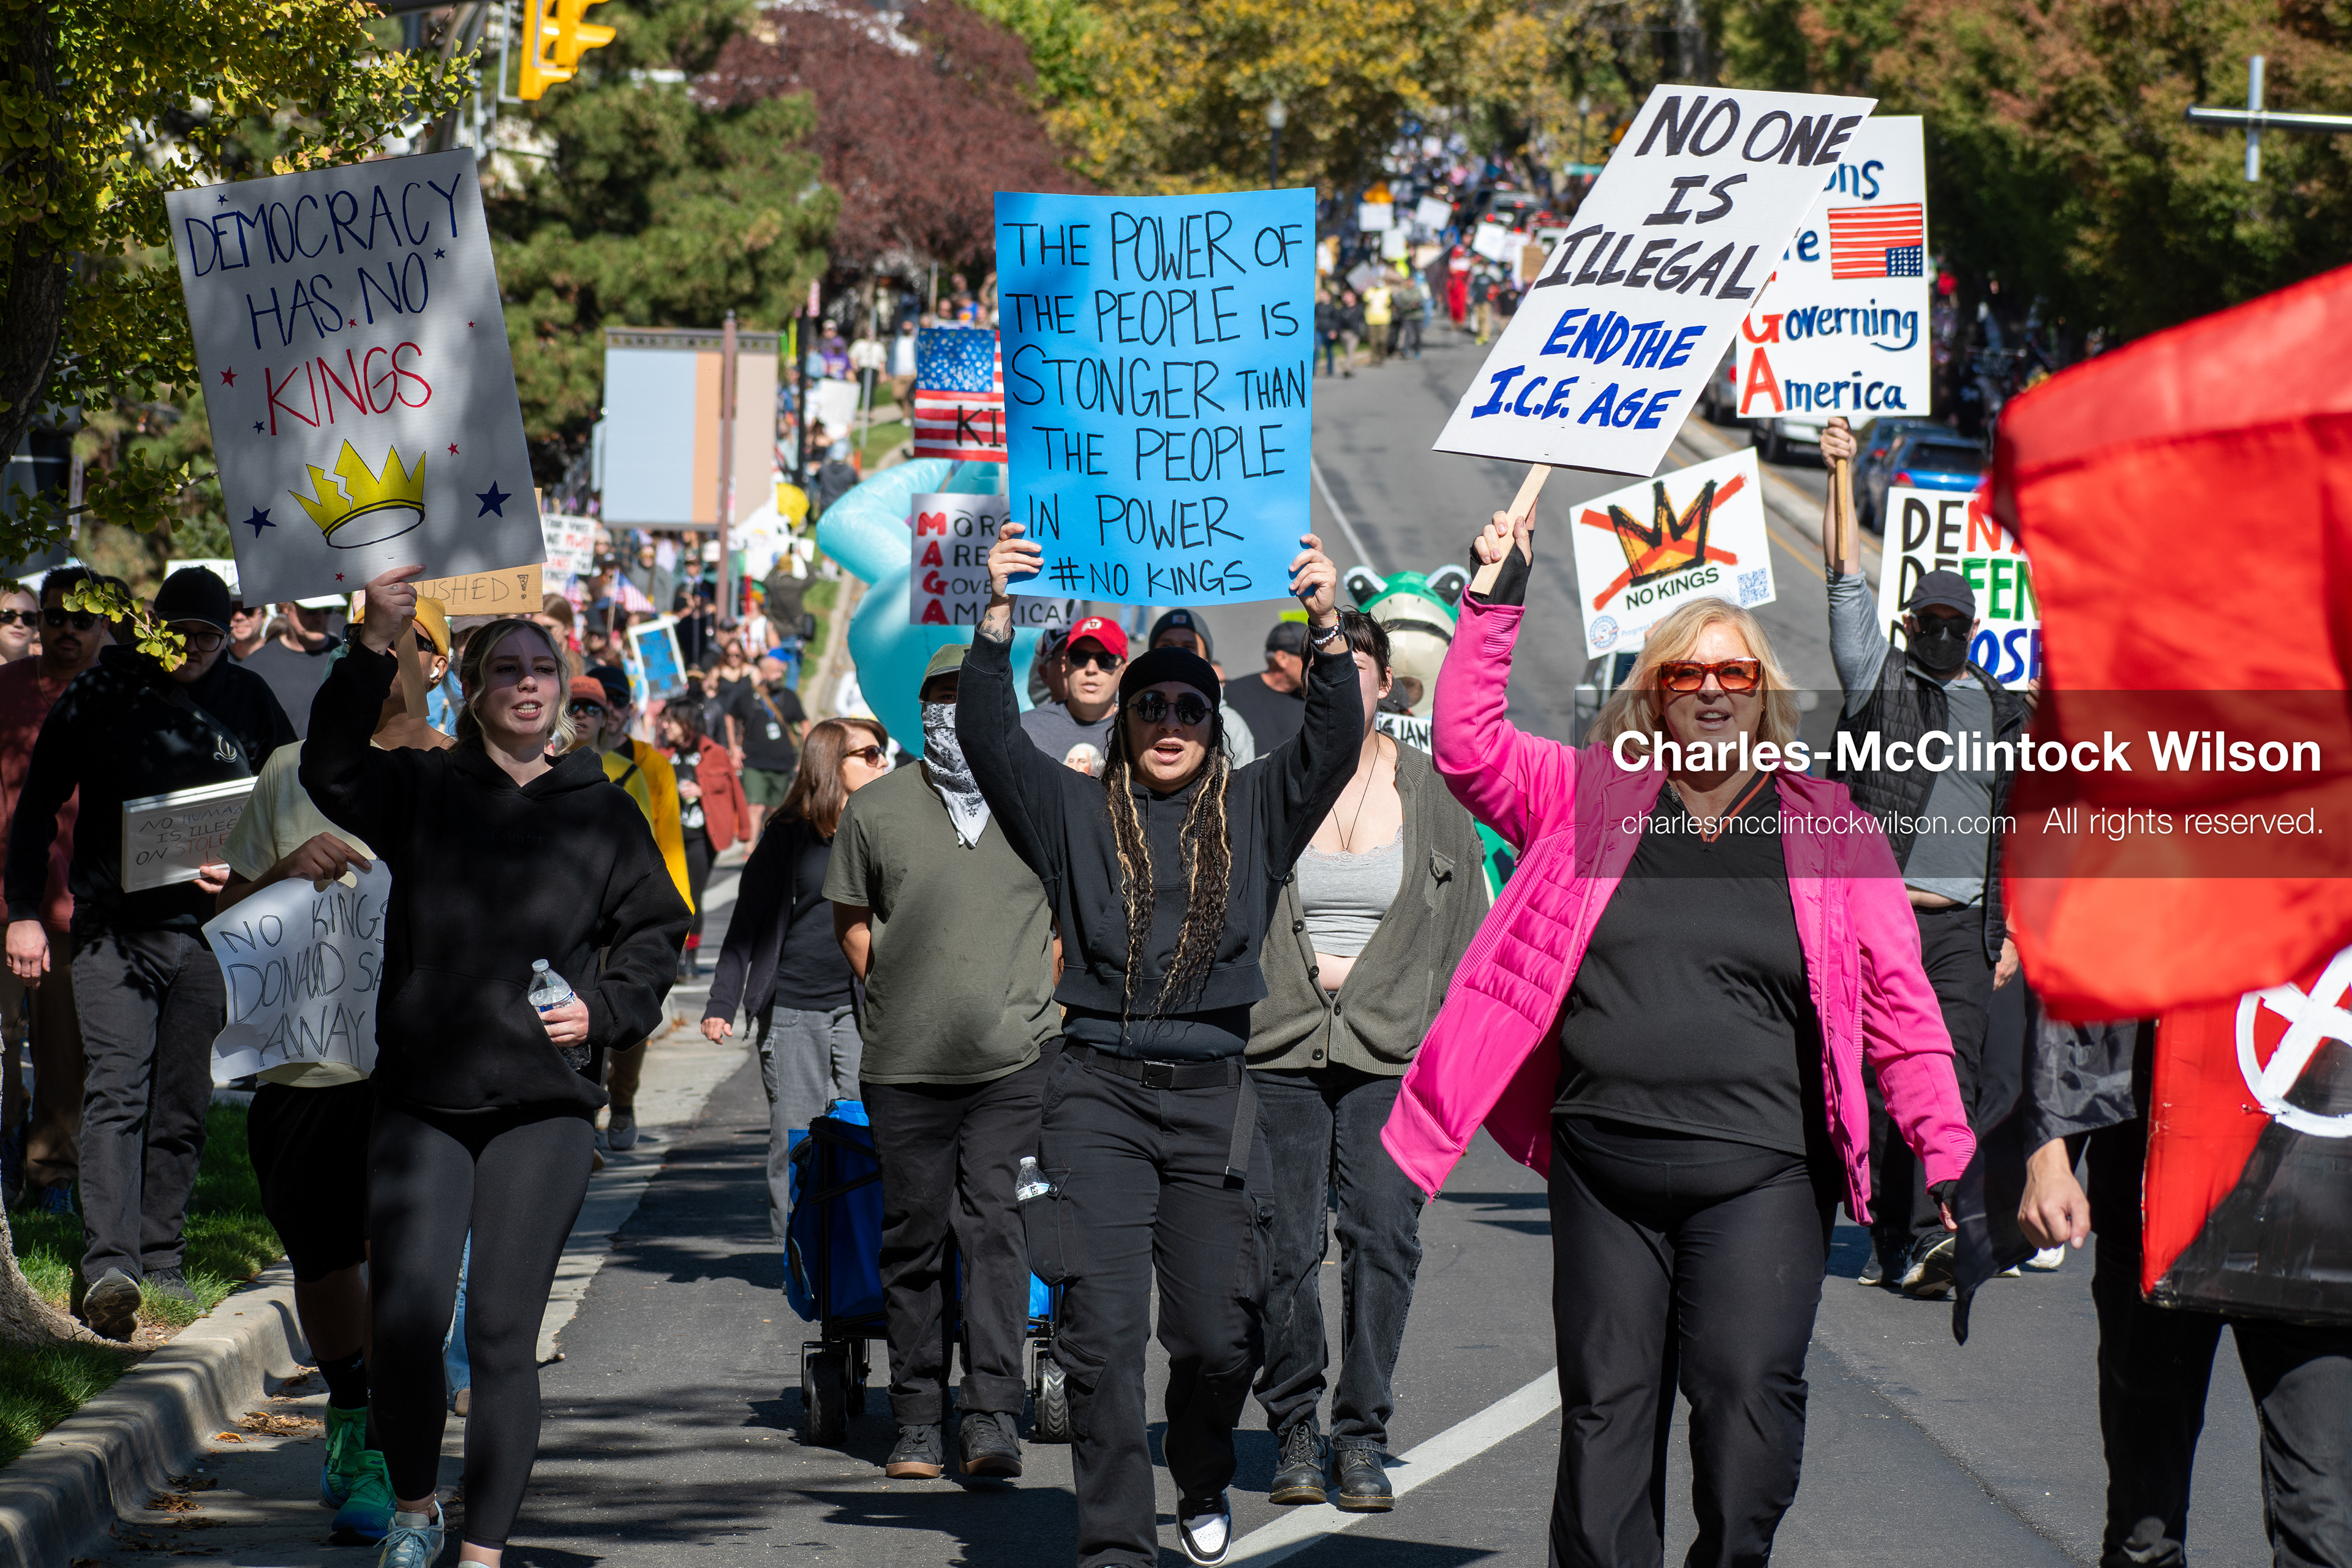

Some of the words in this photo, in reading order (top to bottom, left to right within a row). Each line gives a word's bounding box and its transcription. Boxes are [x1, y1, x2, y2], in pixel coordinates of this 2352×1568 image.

[1634, 96, 1740, 157] NO
[1742, 110, 1862, 166] ONE
[185, 173, 461, 277] DEMOCRACY
[1643, 173, 1747, 225] IS
[1003, 223, 1090, 266] THE
[1112, 211, 1246, 281] POWER
[1255, 225, 1302, 268] OF
[1534, 224, 1759, 300] ILLEGAL
[246, 274, 343, 350] HAS
[358, 252, 429, 325] NO
[1005, 294, 1076, 333] THE
[1095, 286, 1240, 346] PEOPLE
[1261, 301, 1298, 339] IS
[1741, 299, 1918, 352] Governing
[265, 342, 432, 435] KINGS
[1012, 344, 1224, 418] STONGER
[1236, 361, 1305, 410] THAN
[1471, 365, 1579, 419] I.C.E.
[1577, 383, 1681, 429] AGE
[1740, 347, 1907, 415] America
[1032, 427, 1108, 475] THE
[1136, 424, 1285, 481] PEOPLE
[1030, 493, 1060, 540] IN
[1095, 494, 1244, 549] POWER
[1902, 497, 2022, 554] DEN
[409, 575, 528, 605] USHED!
[1049, 557, 1128, 594] #NO
[1147, 560, 1252, 597] KINGS
[1626, 589, 1653, 610] NO
[1657, 568, 1719, 599] KINGS
[922, 598, 1075, 625] AMICA!
[1401, 720, 1431, 750] LAN
[140, 818, 172, 832] NO
[157, 831, 181, 843] IS
[136, 848, 167, 865] ON
[219, 915, 282, 952] NO
[260, 1003, 365, 1070] AWAY
